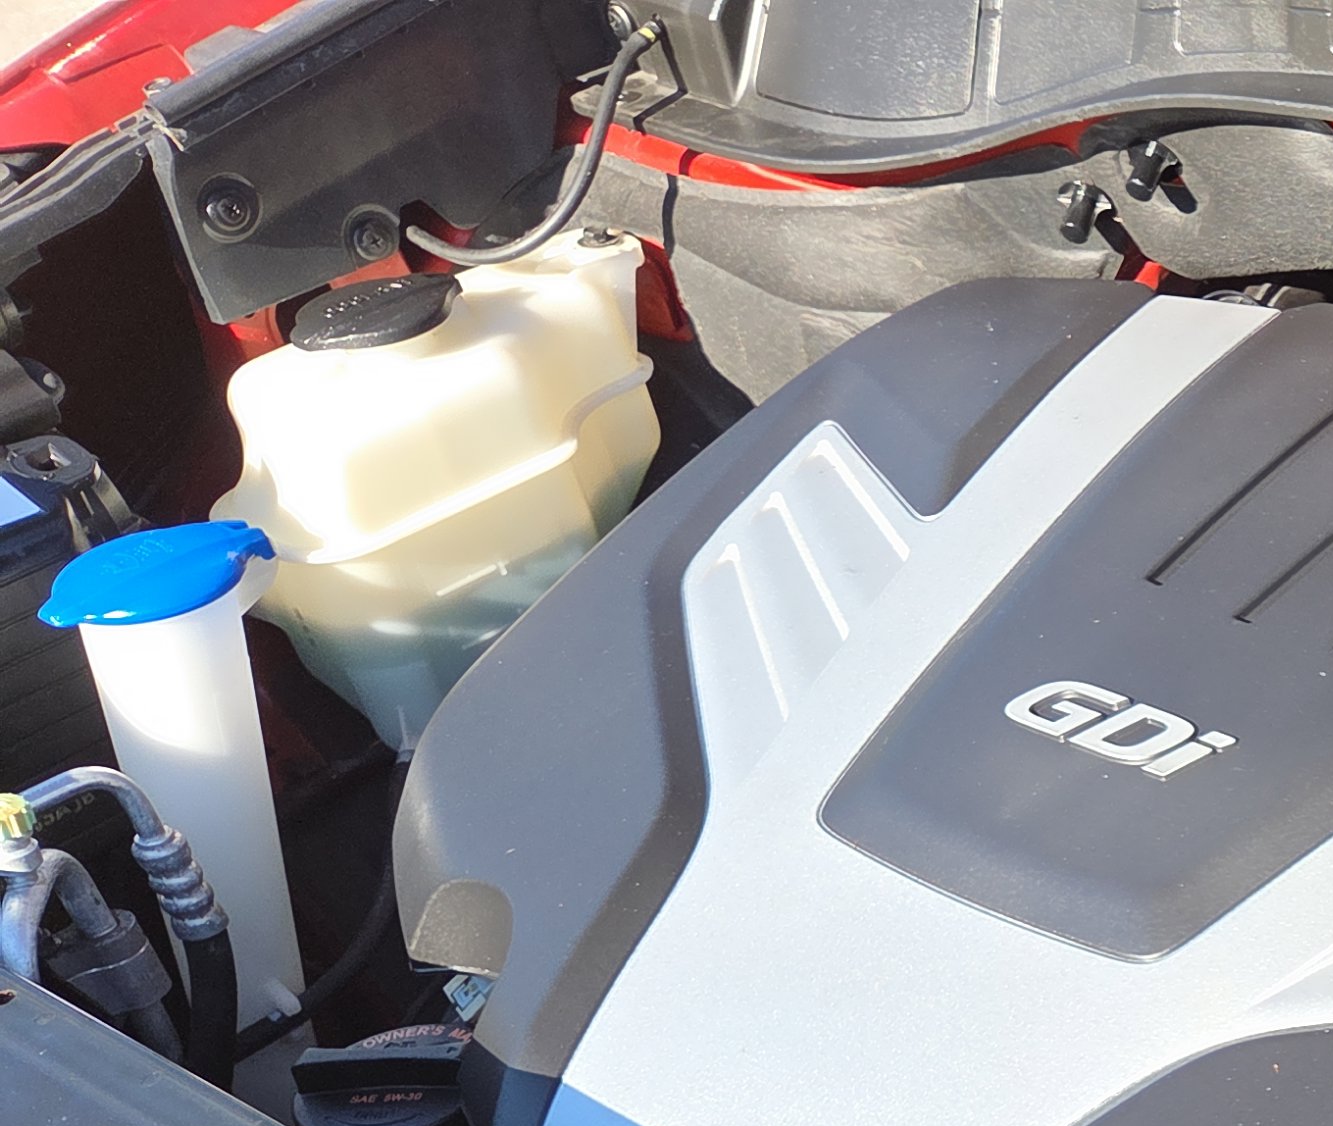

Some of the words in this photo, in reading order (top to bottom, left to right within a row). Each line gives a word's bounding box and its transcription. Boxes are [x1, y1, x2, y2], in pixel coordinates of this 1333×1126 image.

[1004, 680, 1237, 779] GDi
[362, 1024, 446, 1049] OWNER'S
[350, 1094, 379, 1104] SAE
[383, 1092, 423, 1103] 5W-30
